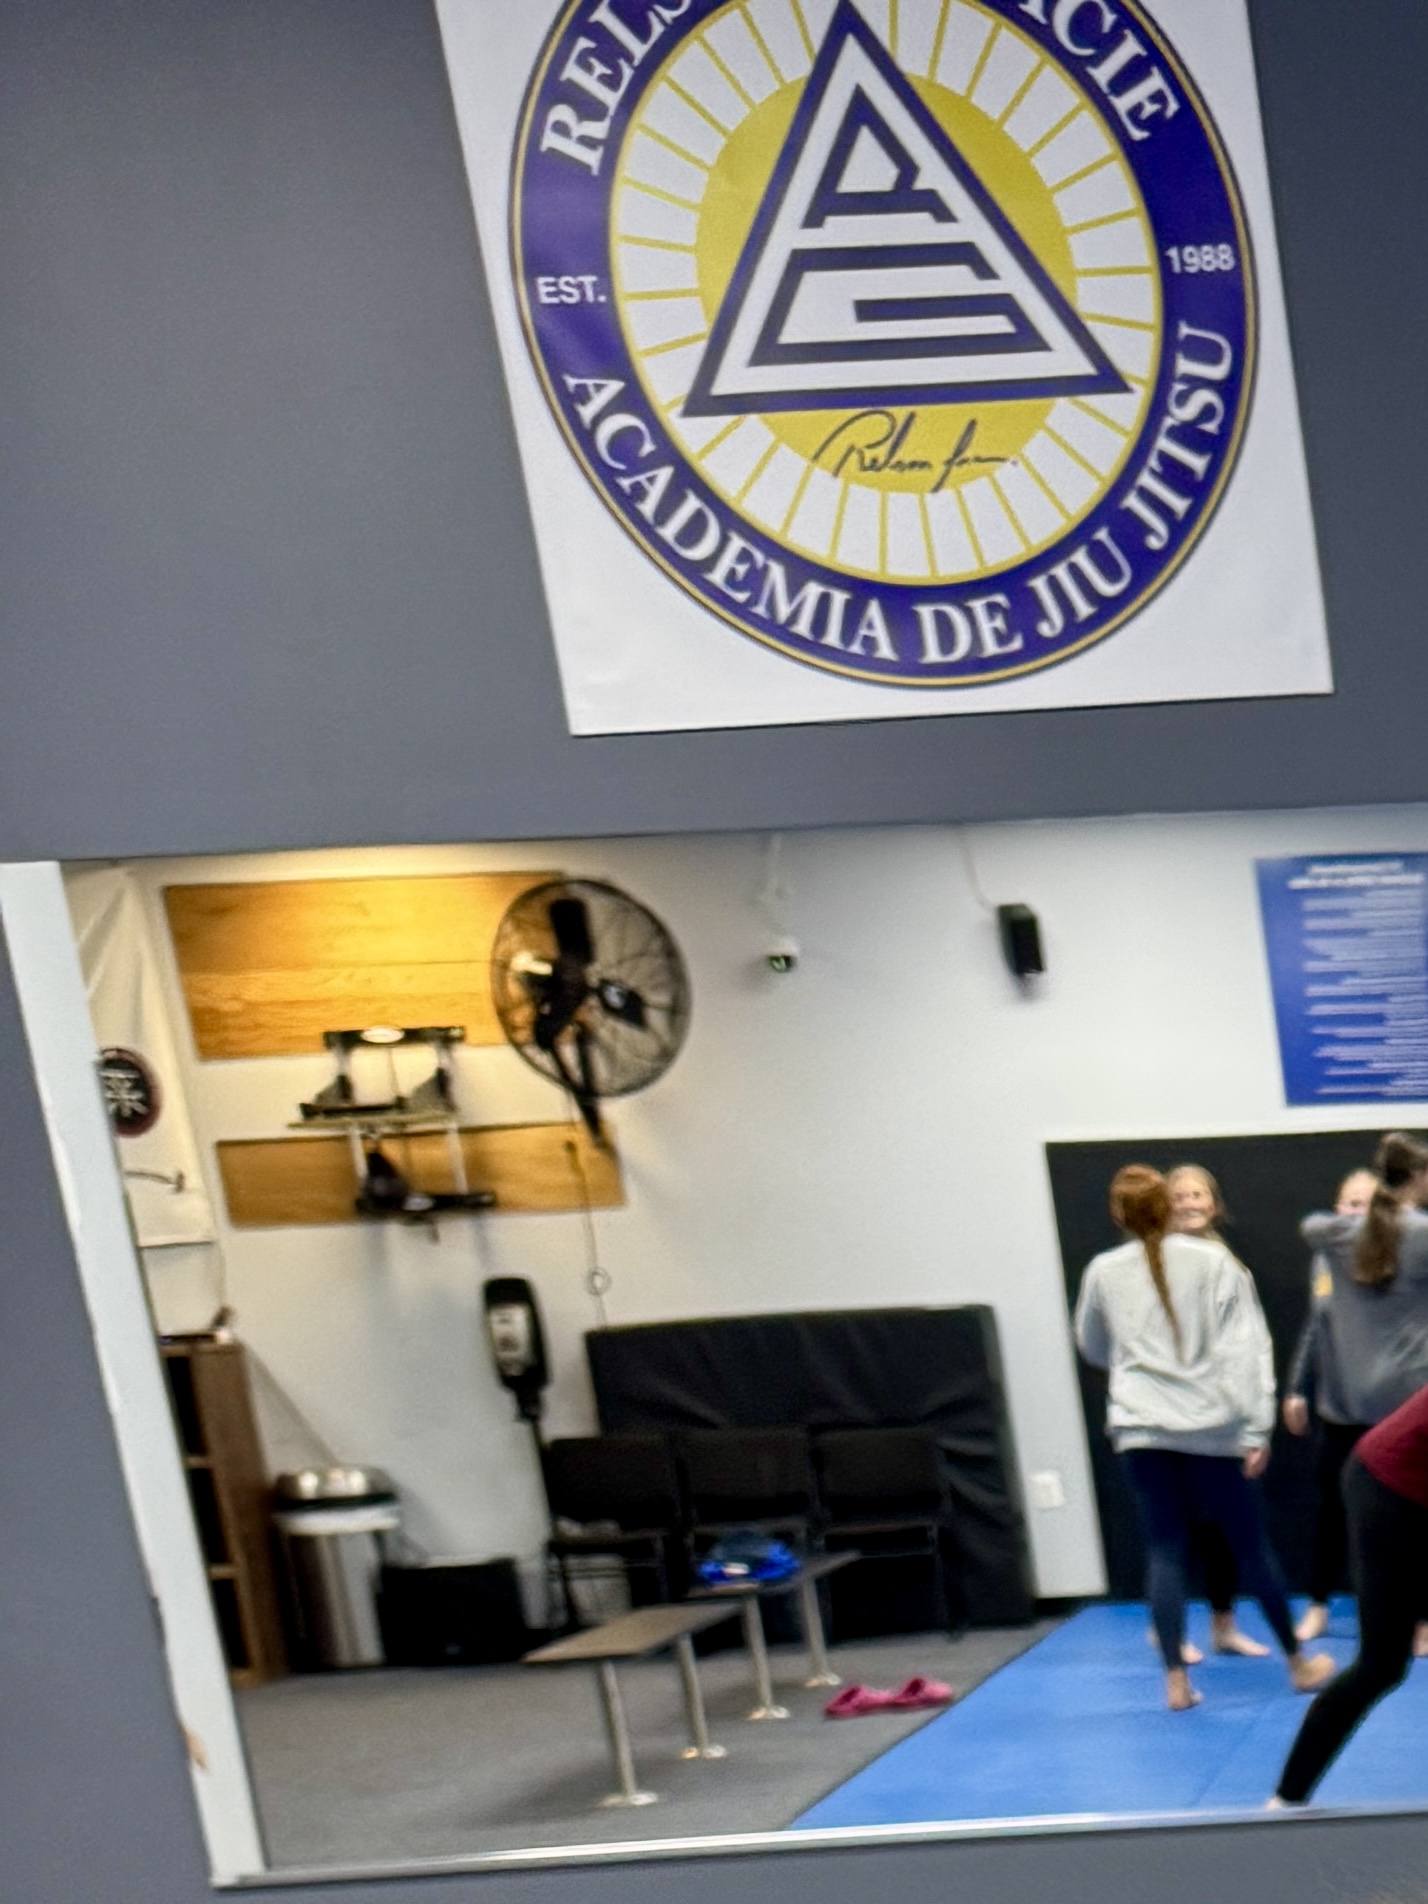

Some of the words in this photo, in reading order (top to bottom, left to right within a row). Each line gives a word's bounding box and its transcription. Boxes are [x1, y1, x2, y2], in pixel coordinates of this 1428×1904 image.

[537, 275, 607, 305] EST.
[1166, 245, 1235, 274] 1988
[563, 372, 899, 662] ACADEMIA
[920, 596, 1024, 665] DE
[1034, 529, 1137, 638] JIU
[1141, 321, 1234, 551] JITSU
